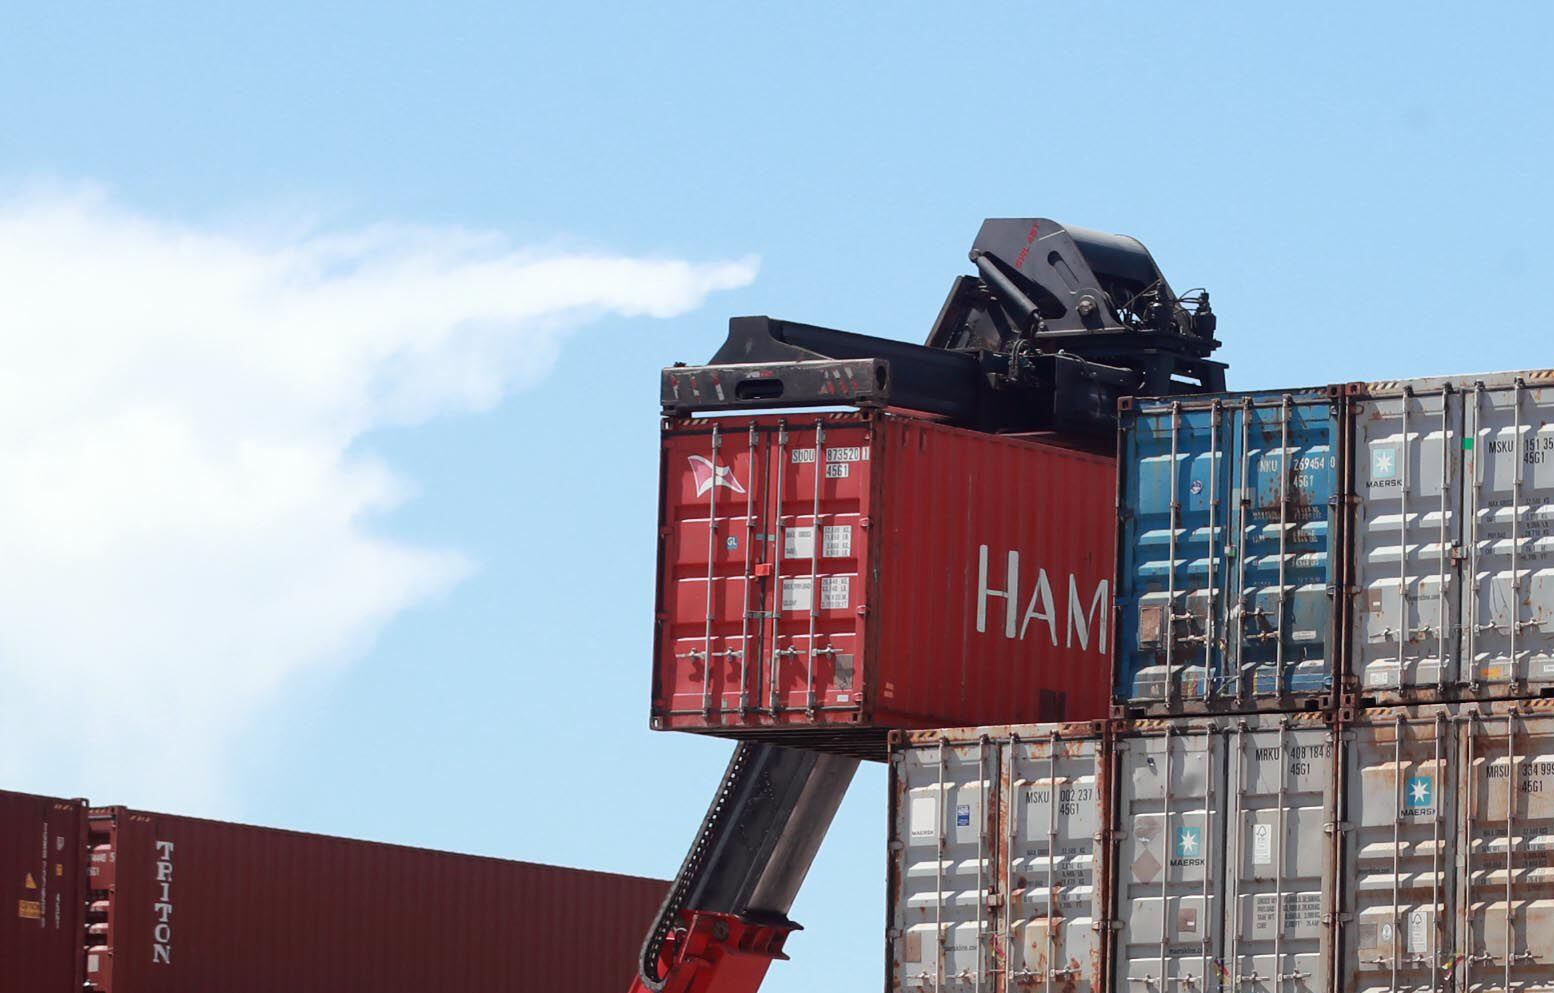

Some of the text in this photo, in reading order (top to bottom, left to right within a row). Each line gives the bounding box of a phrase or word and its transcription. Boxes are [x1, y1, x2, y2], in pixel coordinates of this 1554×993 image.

[976, 545, 1109, 655] HAM
[153, 841, 175, 964] TRITON
[1170, 858, 1205, 867] MAERSK
